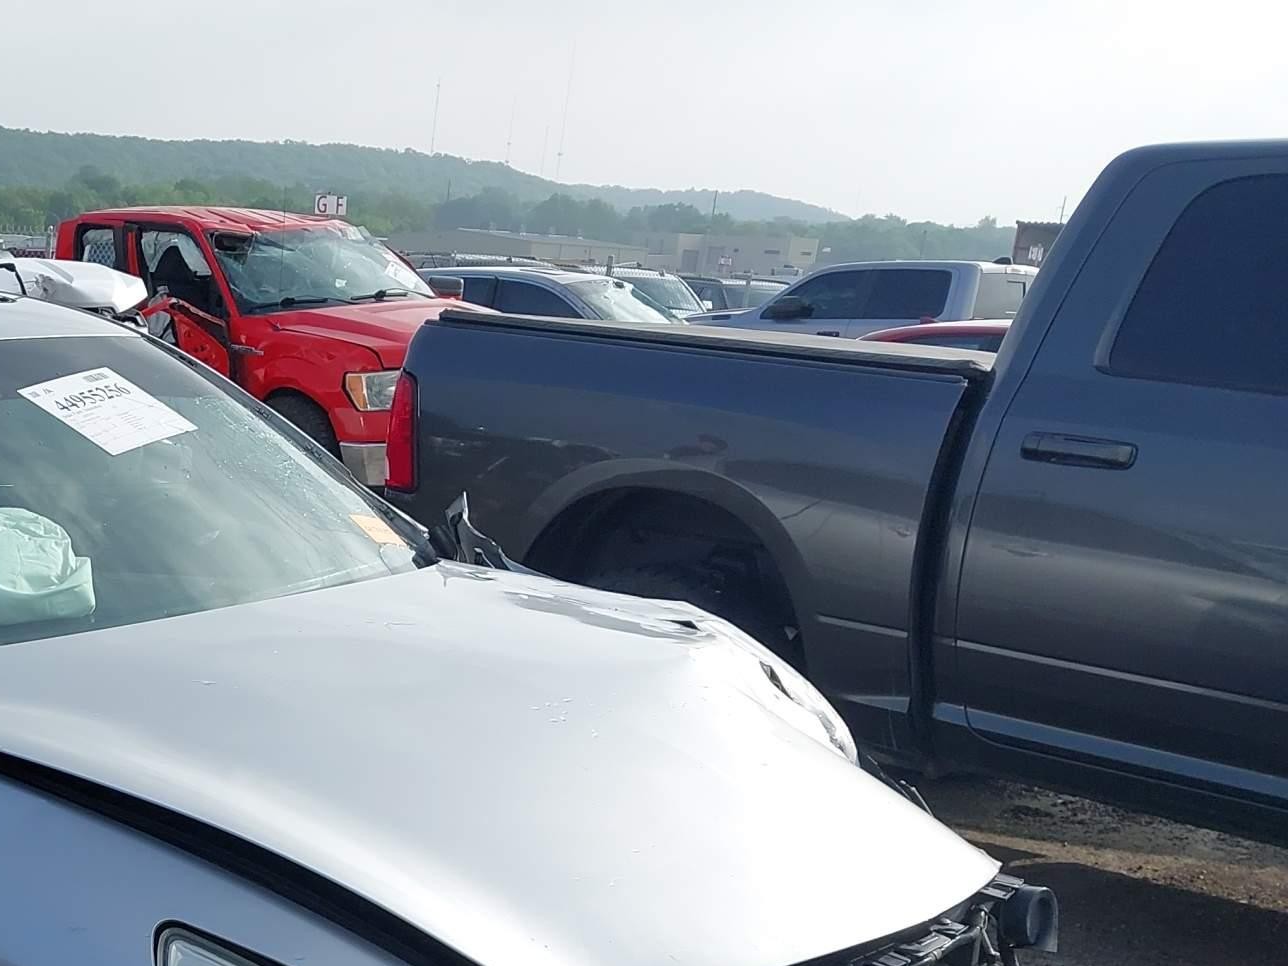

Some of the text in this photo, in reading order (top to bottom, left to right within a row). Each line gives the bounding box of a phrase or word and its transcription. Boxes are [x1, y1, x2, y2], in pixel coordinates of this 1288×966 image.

[317, 195, 344, 214] G F
[54, 382, 131, 412] 44955256
